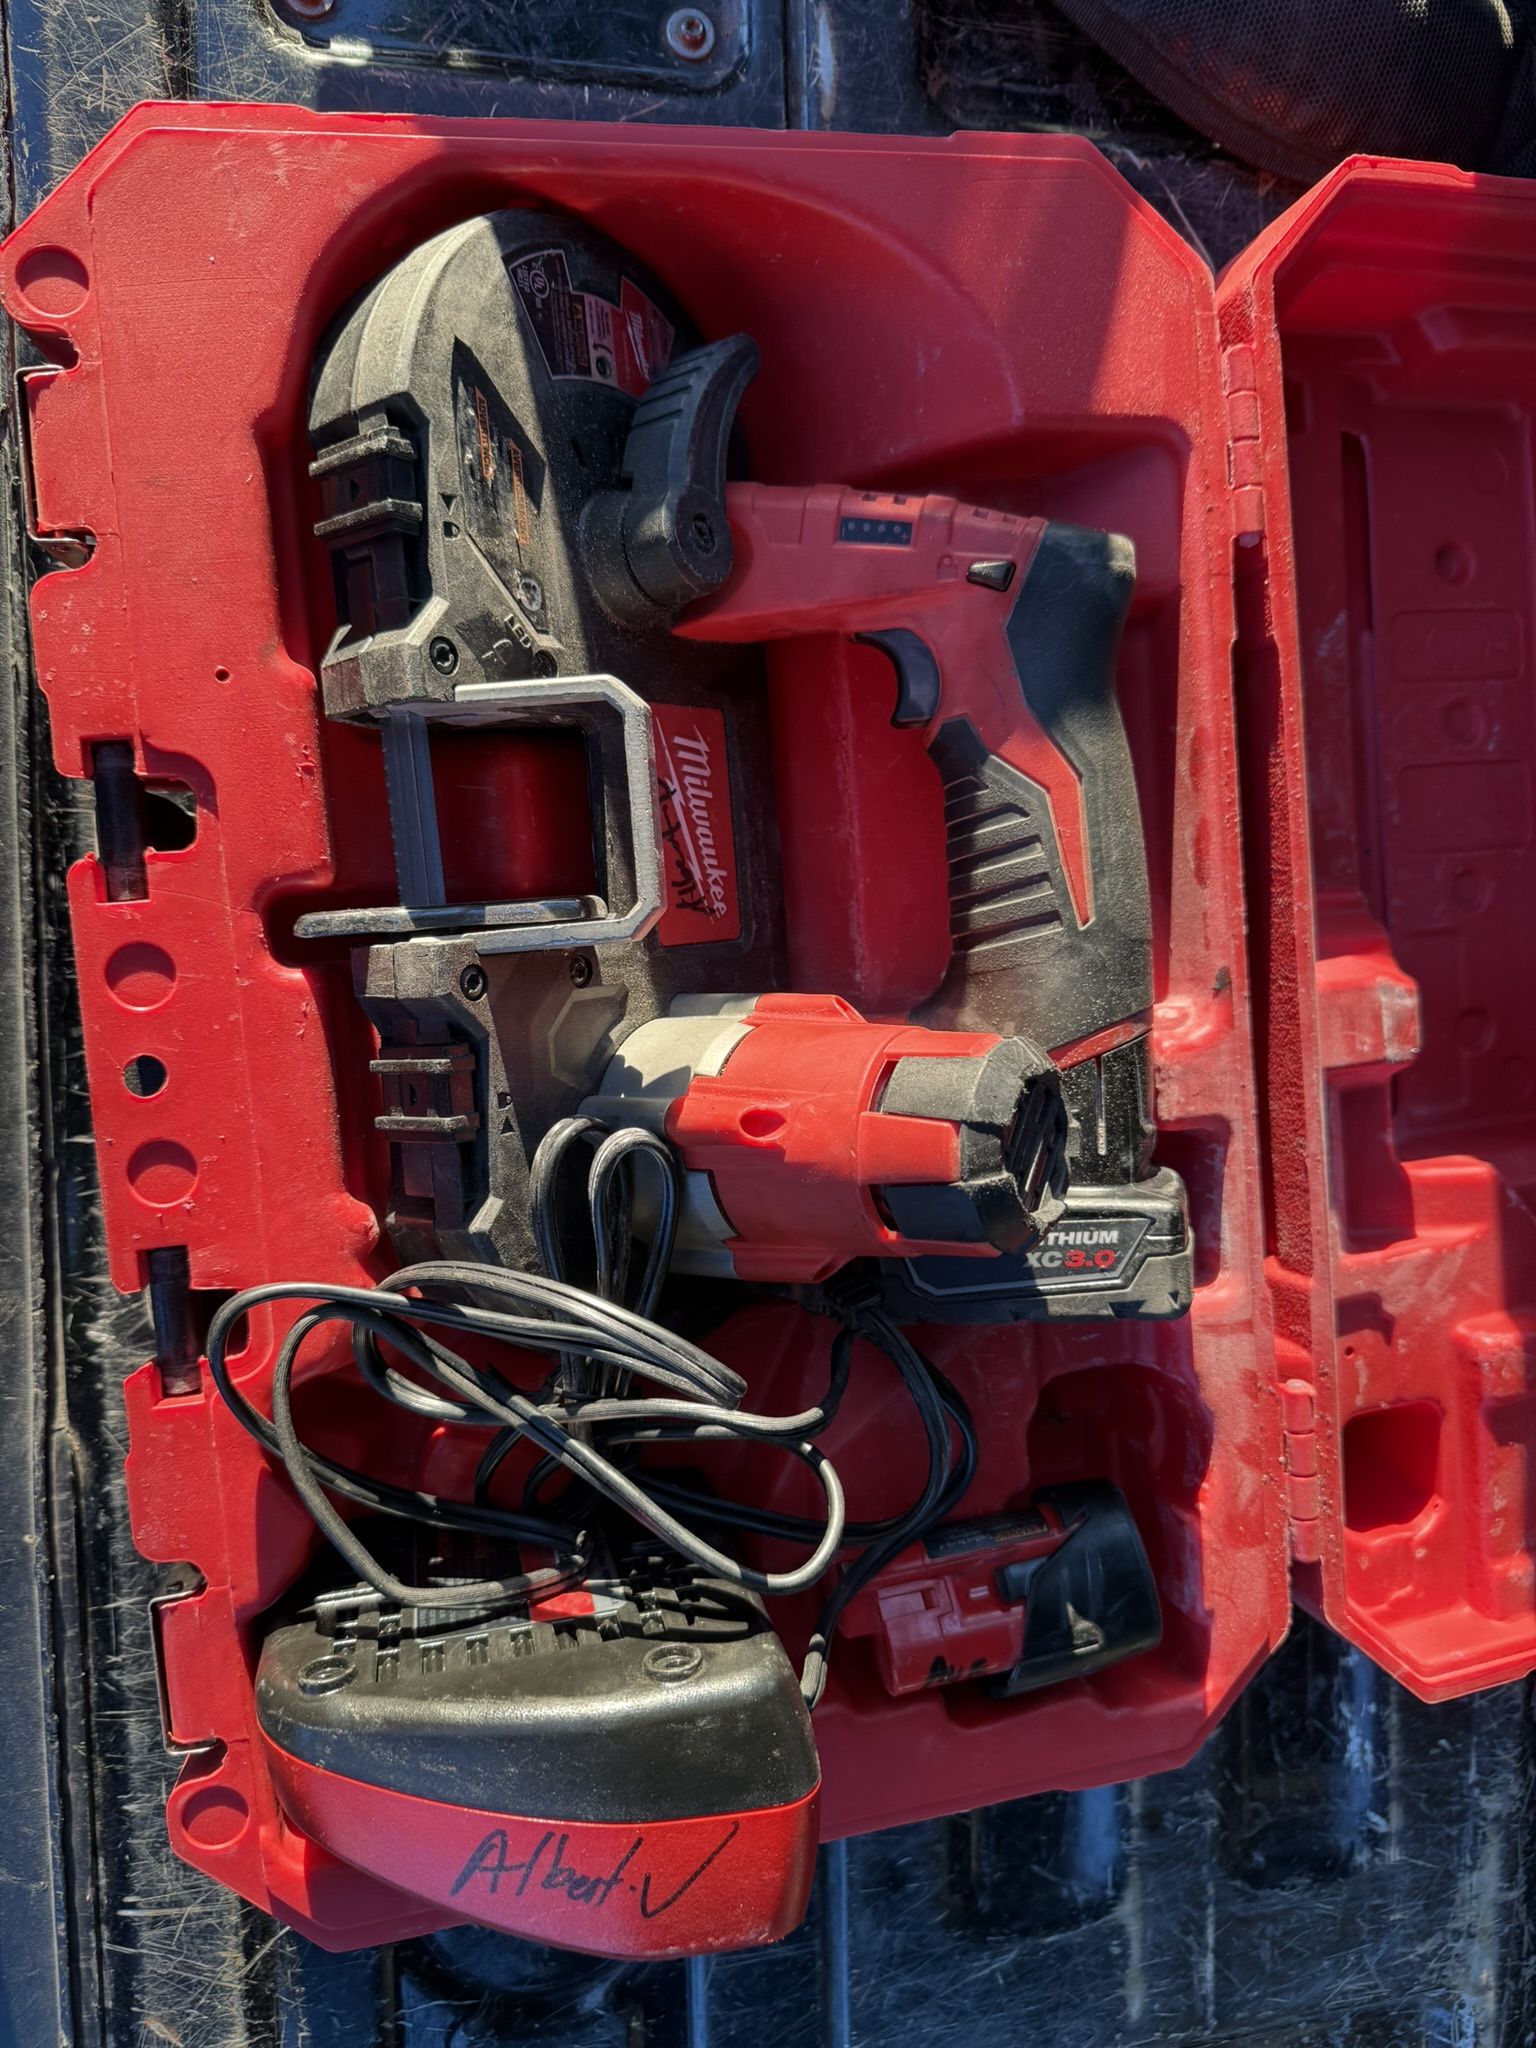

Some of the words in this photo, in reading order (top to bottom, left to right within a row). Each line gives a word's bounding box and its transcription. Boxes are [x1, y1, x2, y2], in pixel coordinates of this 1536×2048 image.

[478, 398, 495, 477] ADVERTENC
[504, 613, 532, 648] LED
[672, 724, 727, 919] Milwaukee
